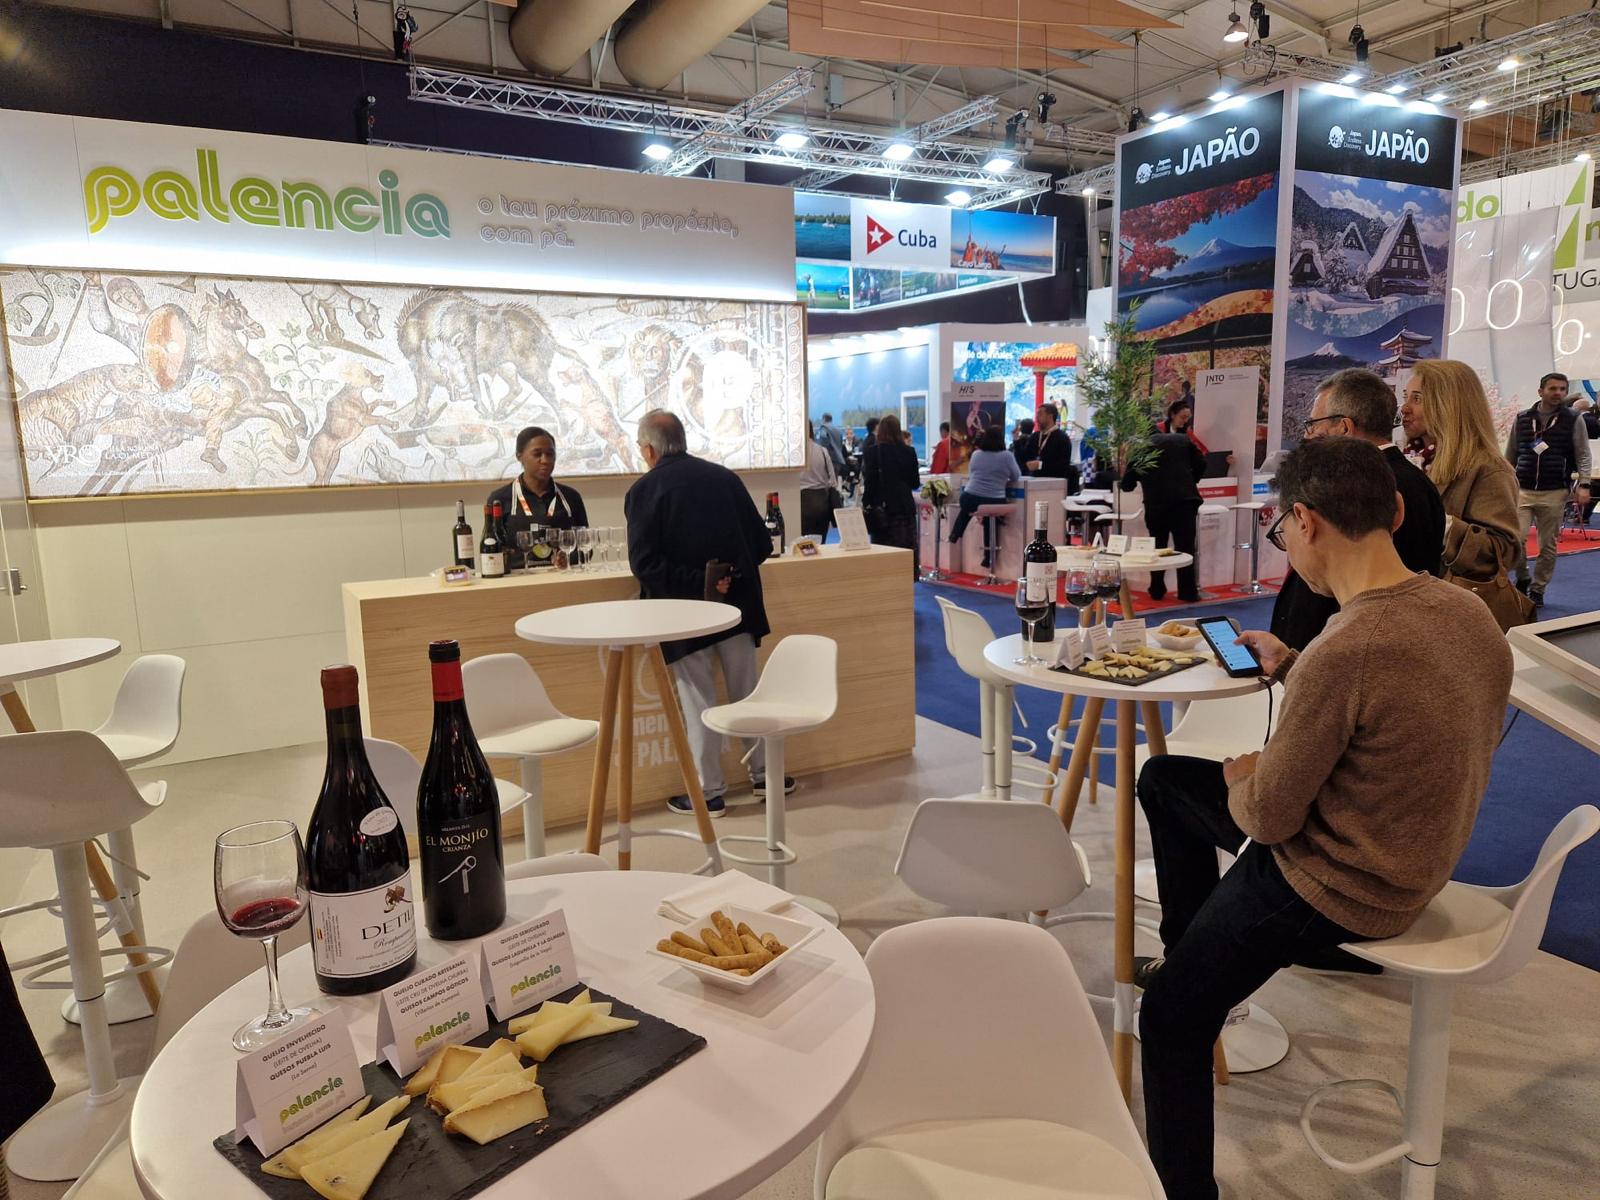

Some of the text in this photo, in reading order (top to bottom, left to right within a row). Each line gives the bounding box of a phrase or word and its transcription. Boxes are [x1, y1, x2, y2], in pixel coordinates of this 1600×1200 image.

[1175, 126, 1260, 176] JAPÃO
[1365, 129, 1430, 164] JAPÃO
[84, 148, 451, 240] palencia
[478, 197, 493, 215] o
[544, 199, 634, 225] próximo
[480, 225, 533, 245] com
[898, 229, 937, 248] Cuba
[1553, 269, 1600, 292] TUG
[1205, 374, 1225, 386] JNTO
[426, 835, 437, 846] EL
[442, 844, 472, 853] CRIANZA
[393, 960, 466, 997] QUEIJO CURADO ARTESANAL
[511, 964, 561, 999] palencia
[400, 1000, 423, 1014] QUESOS
[423, 989, 446, 1003] CAMPOS
[262, 1024, 326, 1062] QUEIJO ENVELHECIDO
[415, 1011, 471, 1050] palencia
[269, 1043, 332, 1081] QUESOS PUEBLA LUIS
[279, 1077, 344, 1125] palencia
